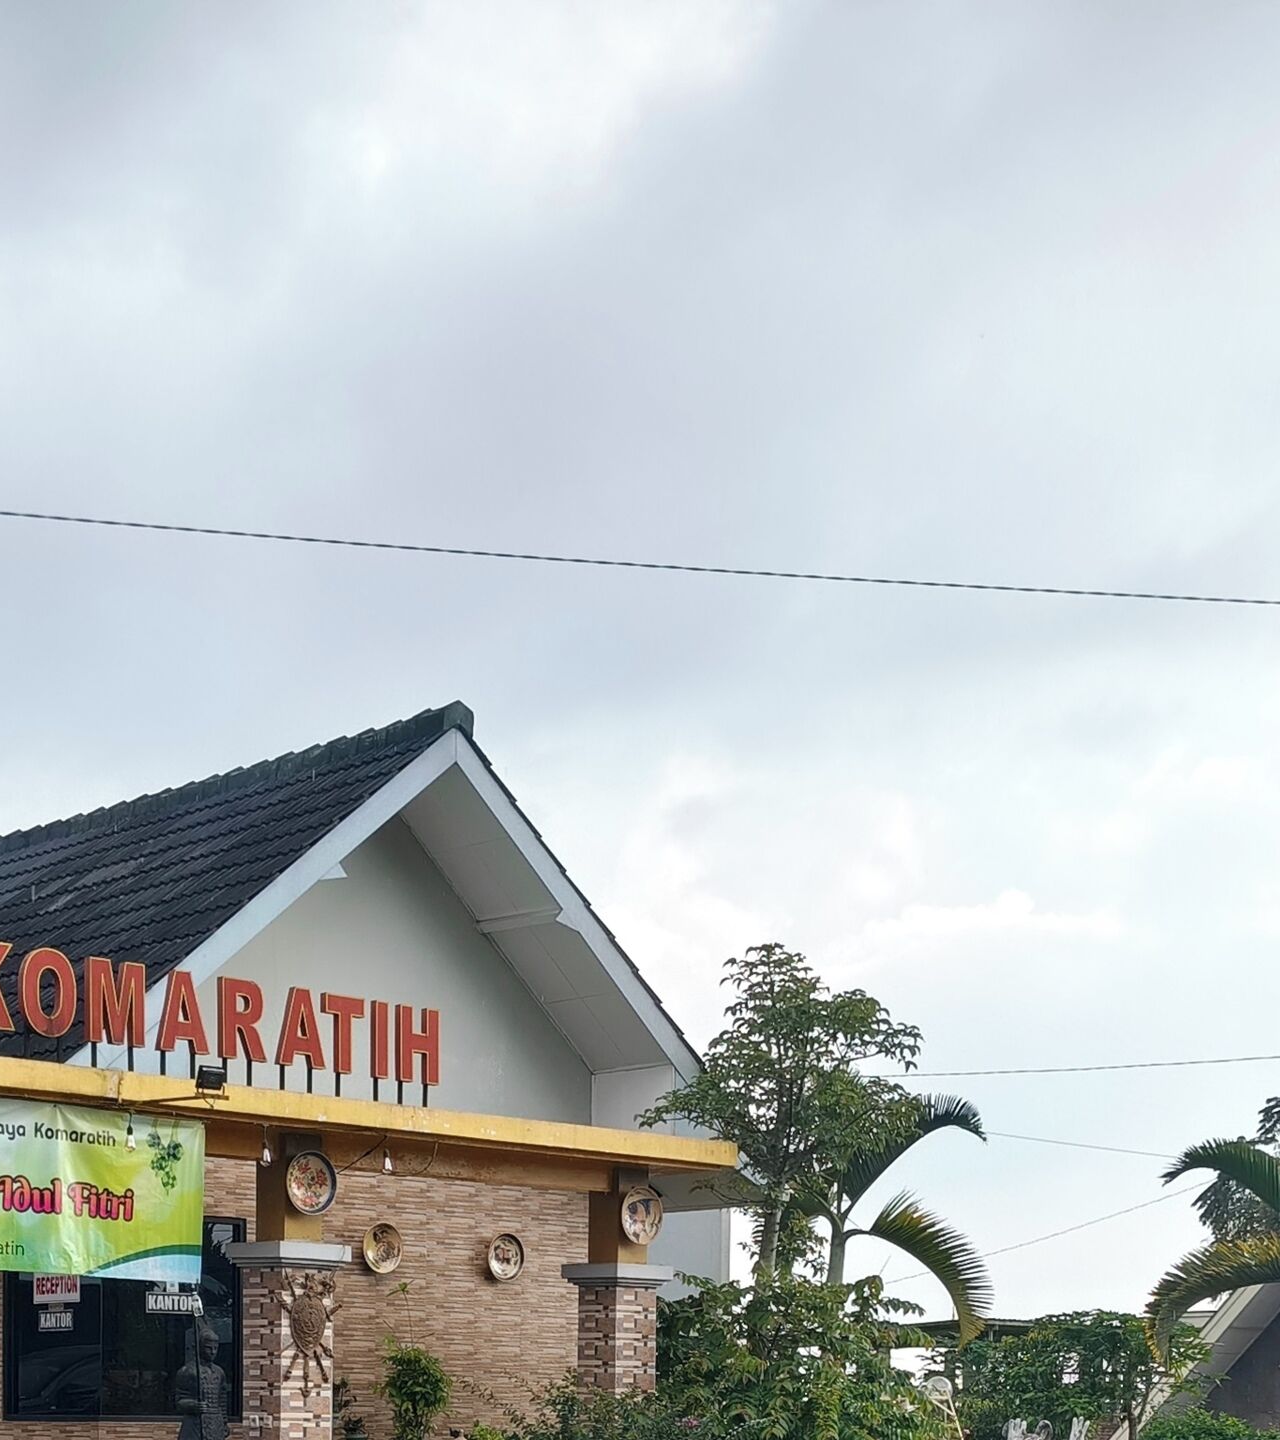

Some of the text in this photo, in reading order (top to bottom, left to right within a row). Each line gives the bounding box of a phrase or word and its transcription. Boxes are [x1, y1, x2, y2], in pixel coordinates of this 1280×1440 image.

[34, 1122, 116, 1147] Komaratih
[67, 1182, 134, 1222] Fitri
[36, 1275, 78, 1295] RECEPTION
[40, 1312, 72, 1328] KANTOR
